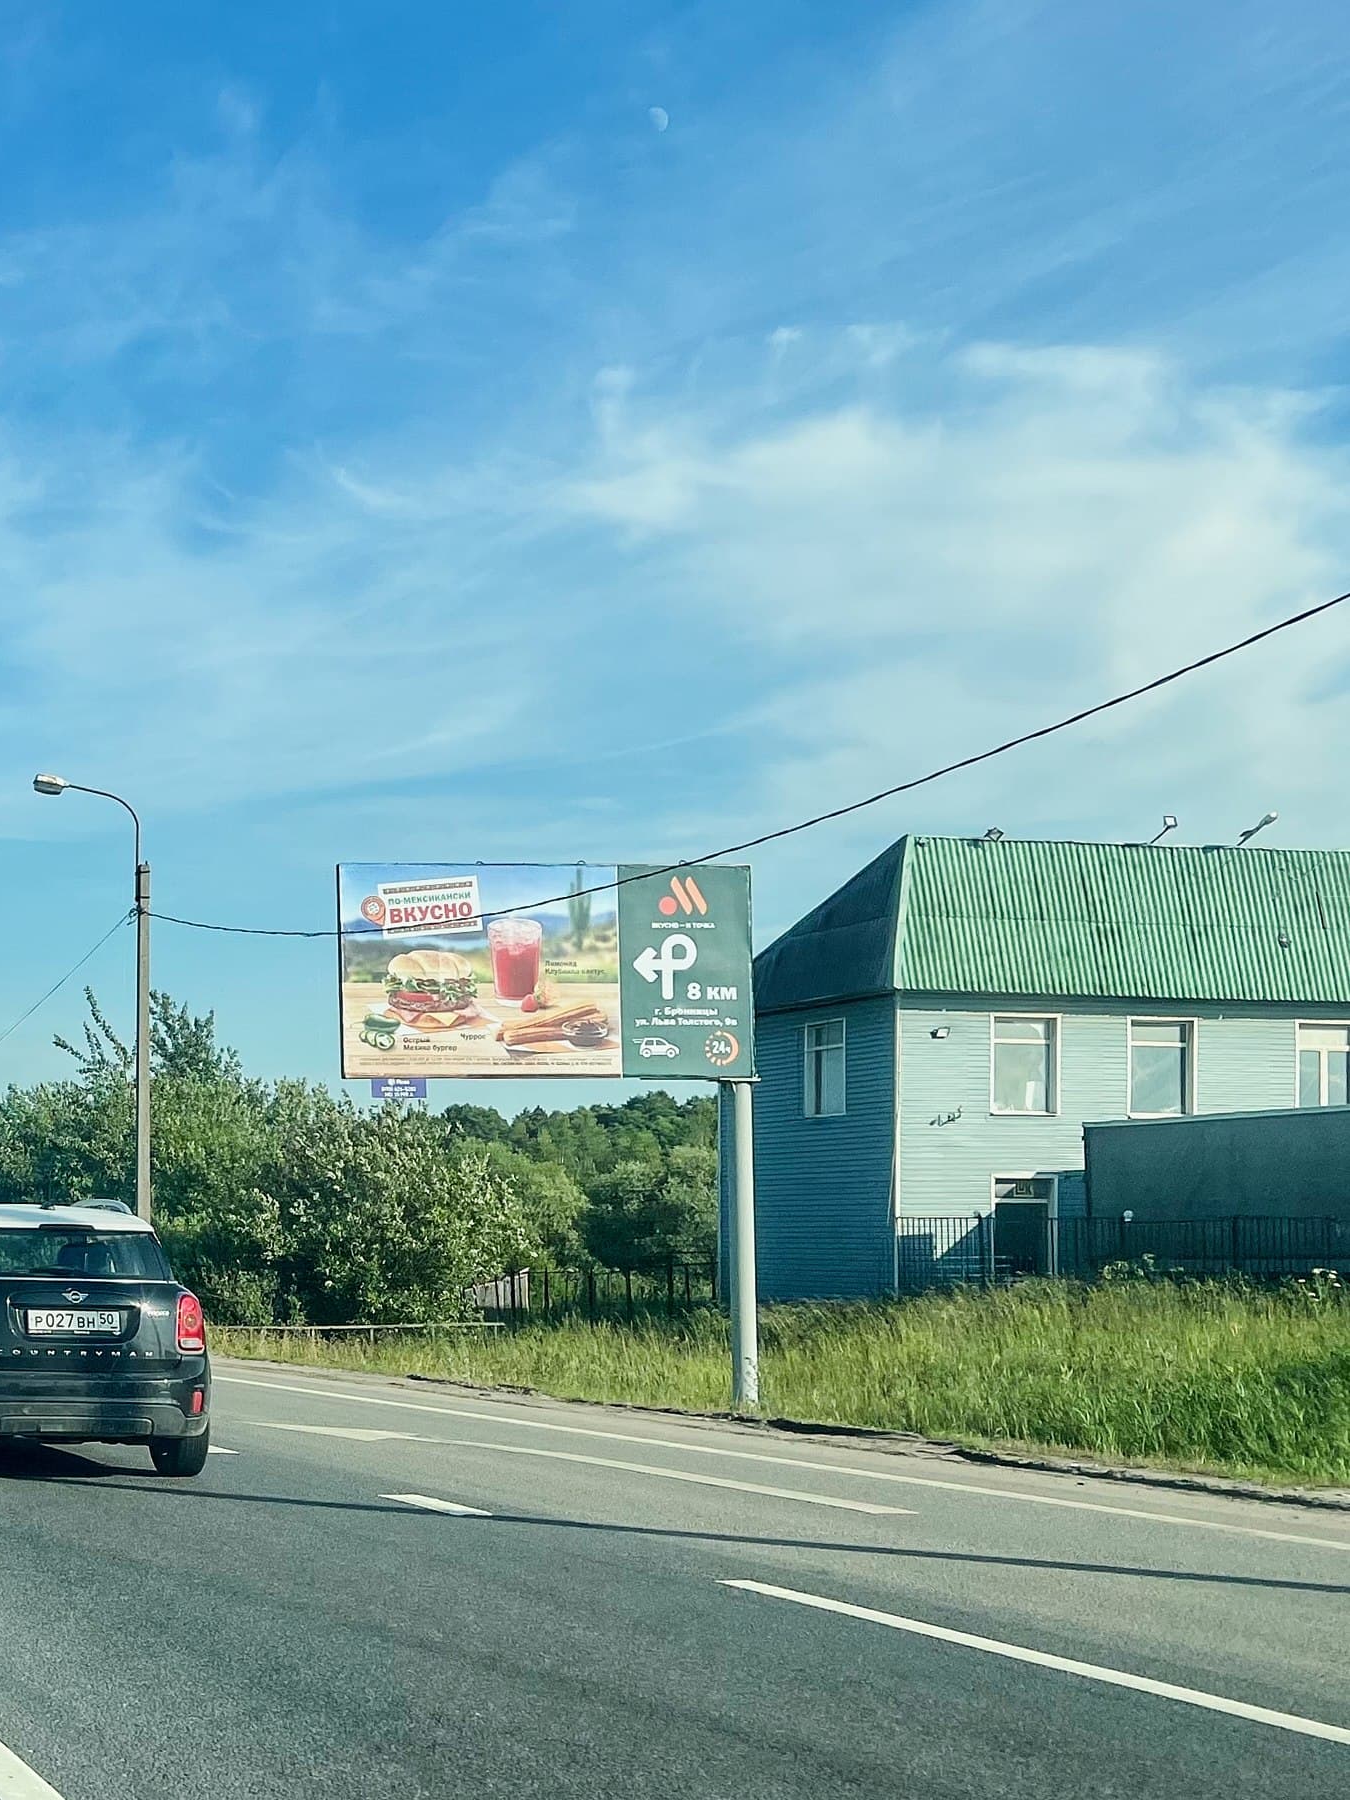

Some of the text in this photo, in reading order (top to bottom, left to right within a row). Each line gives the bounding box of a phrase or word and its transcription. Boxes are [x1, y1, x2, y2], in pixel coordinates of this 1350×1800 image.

[388, 891, 471, 905] ПО-МЕКСИКАНСКИ
[389, 901, 473, 924] ВКУСНО
[687, 982, 702, 1000] 8
[664, 1006, 718, 1017] Бронницы
[651, 1017, 676, 1026] Льва
[99, 1313, 114, 1325] 50
